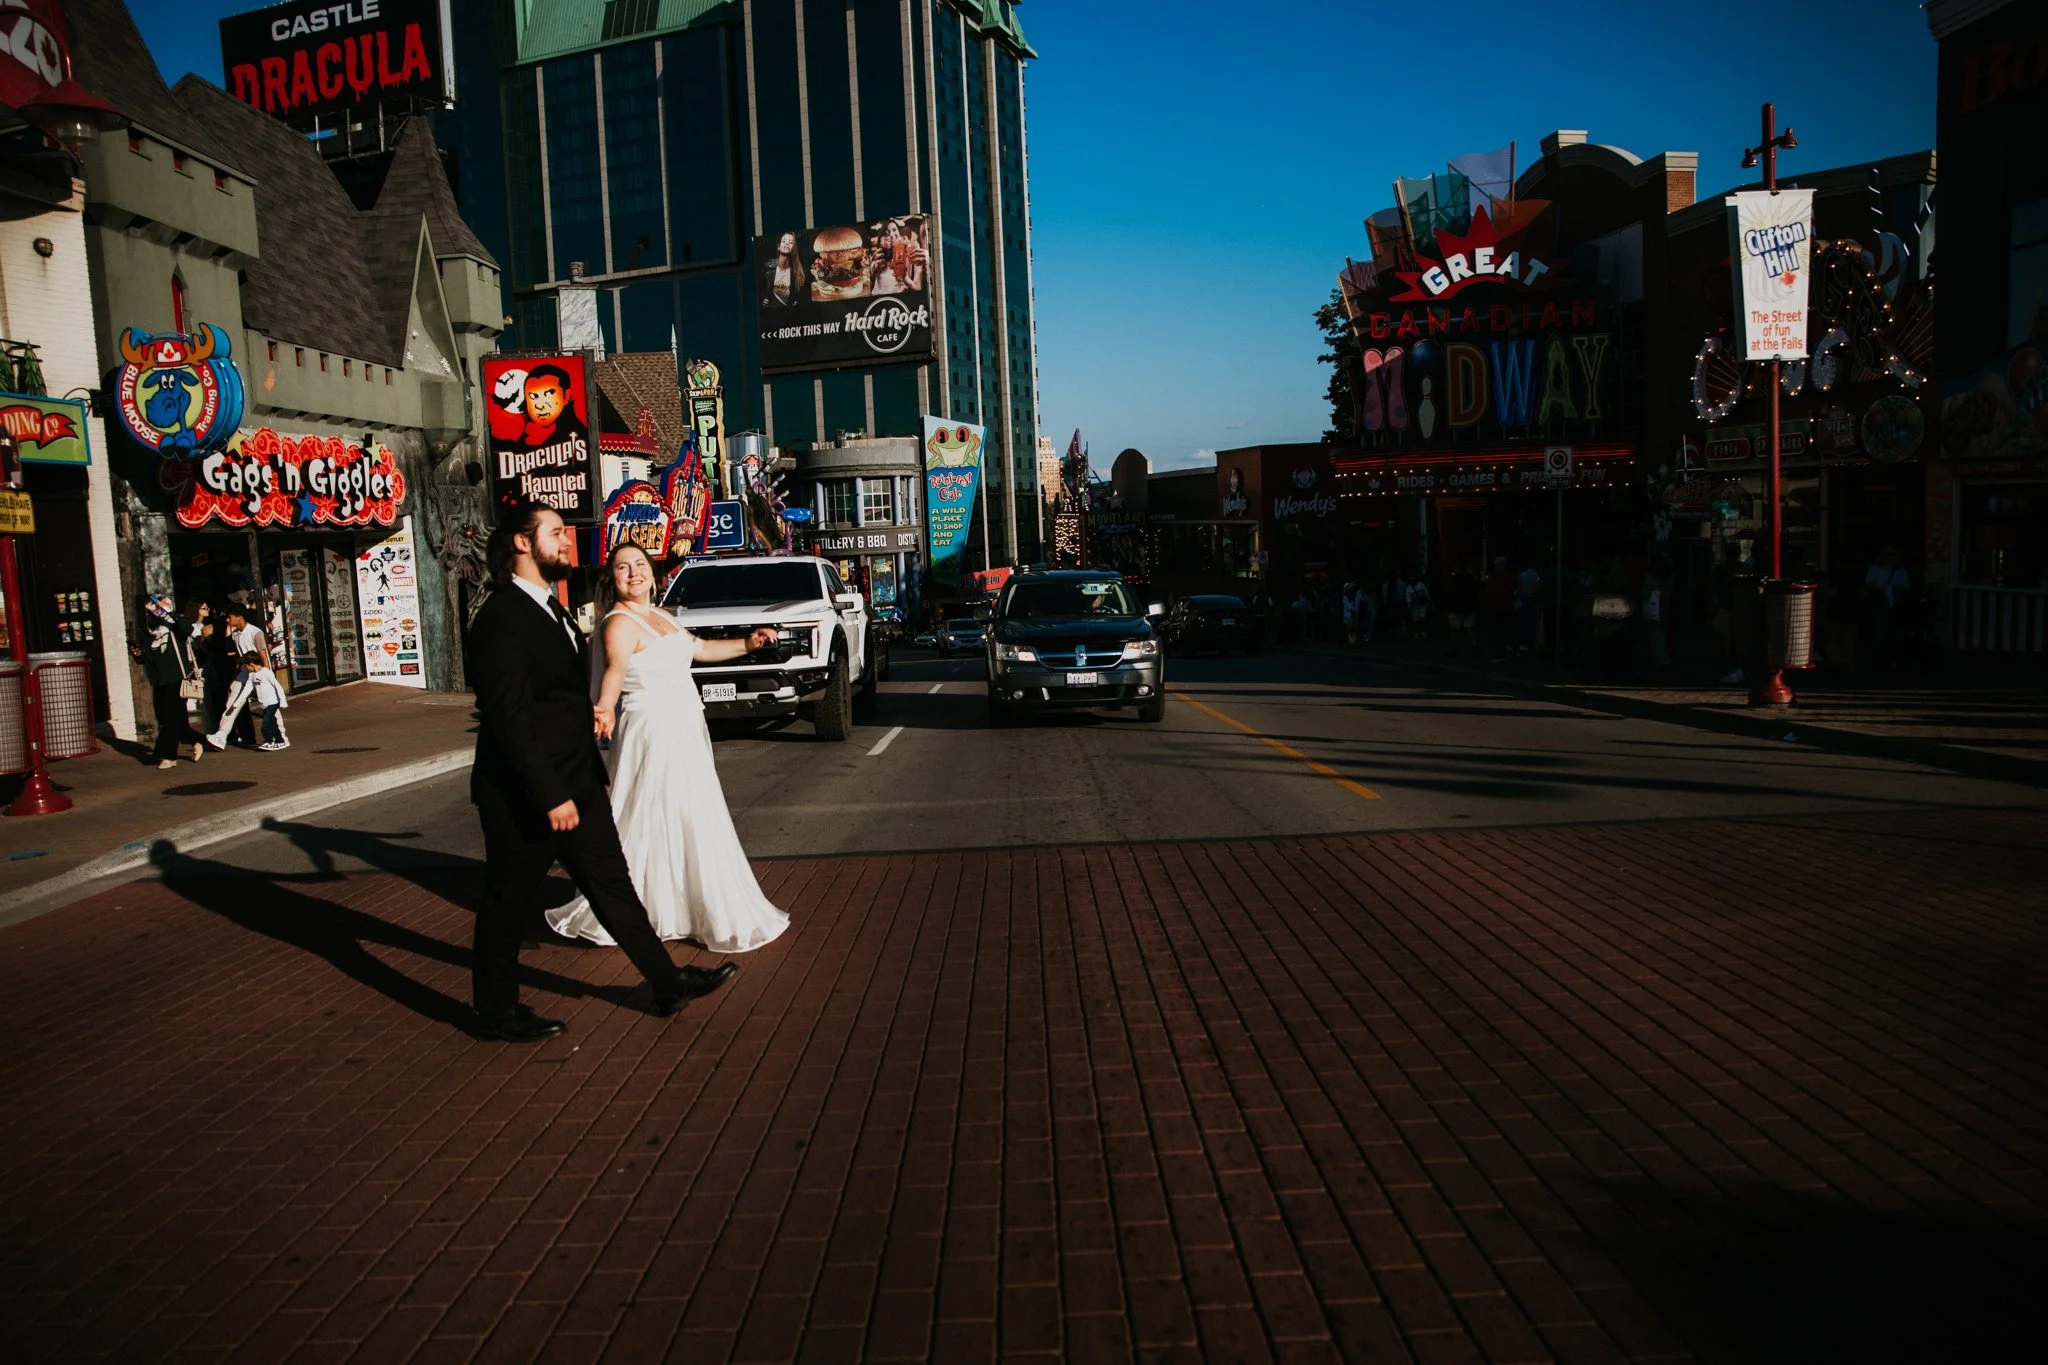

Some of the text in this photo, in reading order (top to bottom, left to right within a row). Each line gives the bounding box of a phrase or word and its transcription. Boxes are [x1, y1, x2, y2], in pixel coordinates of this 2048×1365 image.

[270, 0, 380, 41] CASTLE
[232, 22, 432, 116] DRACULA
[1745, 221, 1807, 256] Clifton
[1421, 246, 1551, 296] GREAT
[1763, 245, 1800, 278] Hill
[844, 304, 929, 333] Hard Rock
[1369, 296, 1597, 339] CANADIAN
[1751, 310, 1802, 324] The Street
[1762, 323, 1790, 337] of fun
[779, 321, 841, 340] ROCK THIS WAY
[877, 333, 899, 343] CAFE
[1751, 337, 1803, 351] at the Falls
[121, 364, 160, 444] BLUE MOOSE
[196, 388, 218, 433] Trading
[697, 415, 719, 500] PUTT
[202, 451, 273, 514] Gags
[308, 456, 394, 517] Giggles
[520, 472, 588, 496] Haunted
[929, 471, 973, 489] Rainforest
[1397, 475, 1435, 488] RIDES
[1448, 473, 1496, 487] GAMES
[1580, 468, 1608, 481] FUN
[1223, 492, 1248, 518] Wendy's
[1273, 490, 1338, 520] Wendy's
[609, 523, 666, 549] LASERS
[857, 536, 865, 549] &
[867, 534, 888, 548] BBQ
[933, 531, 953, 539] AND
[933, 539, 952, 547] EAT
[363, 608, 383, 616] zippo
